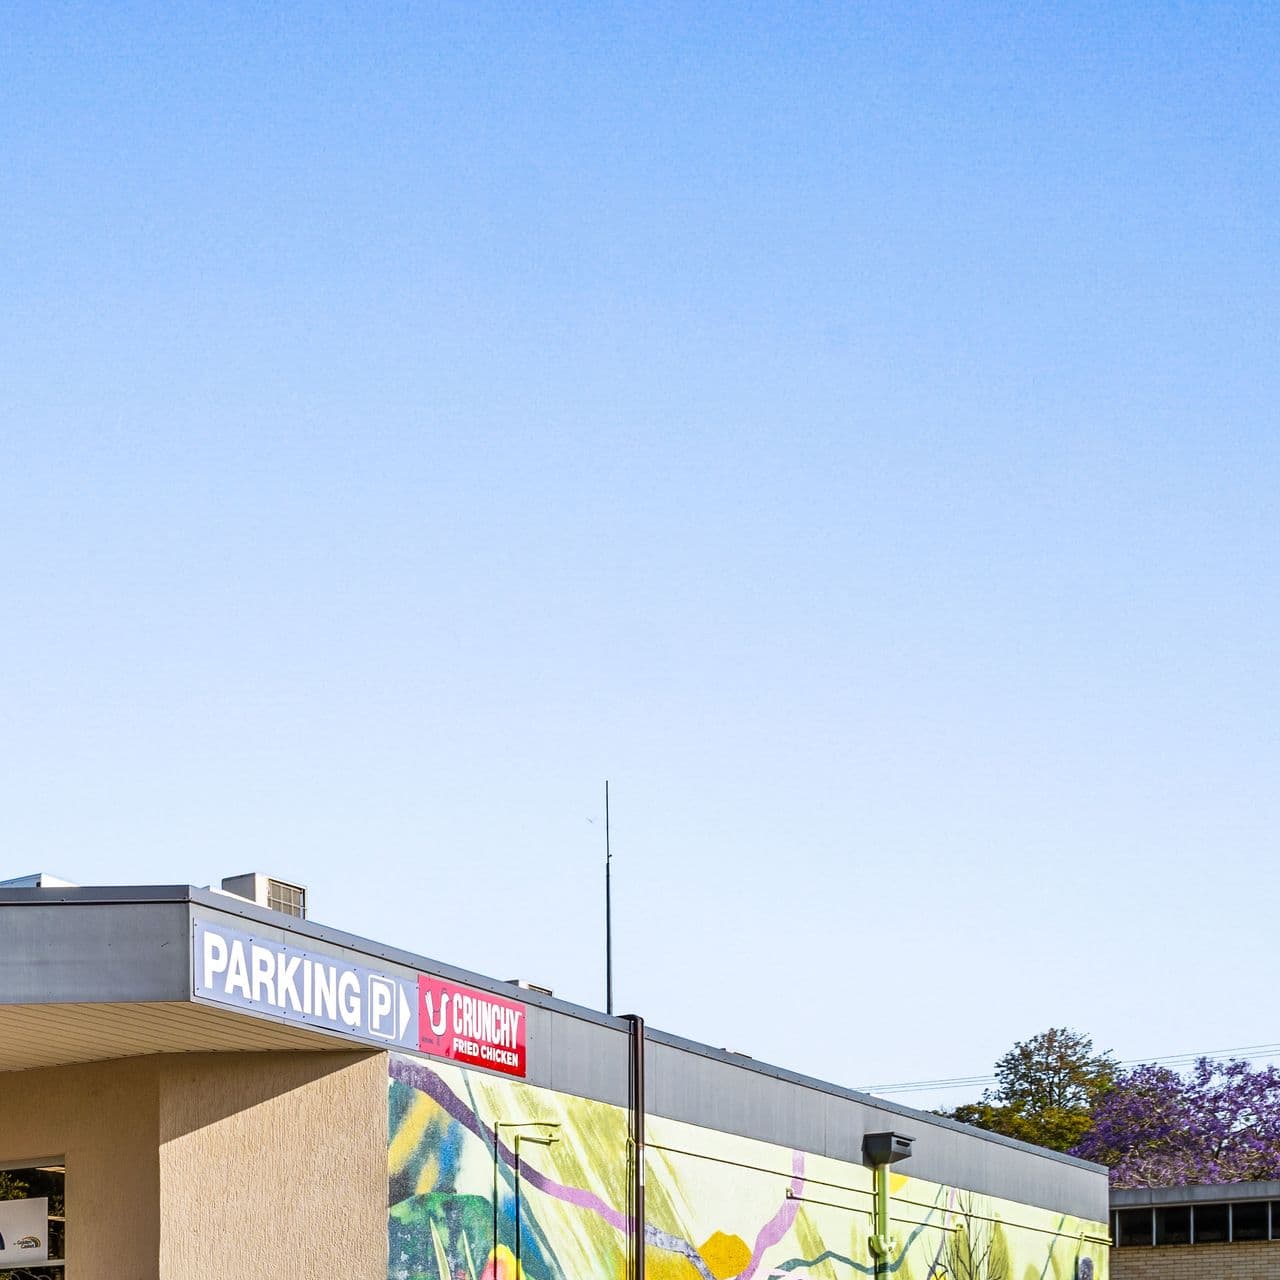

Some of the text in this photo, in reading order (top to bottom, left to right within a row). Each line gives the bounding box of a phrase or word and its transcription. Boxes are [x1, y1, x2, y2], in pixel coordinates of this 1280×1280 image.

[203, 931, 391, 1030] PARKING P
[453, 993, 522, 1049] CRUNCHY
[453, 1037, 518, 1067] FRIED CHICKEN
